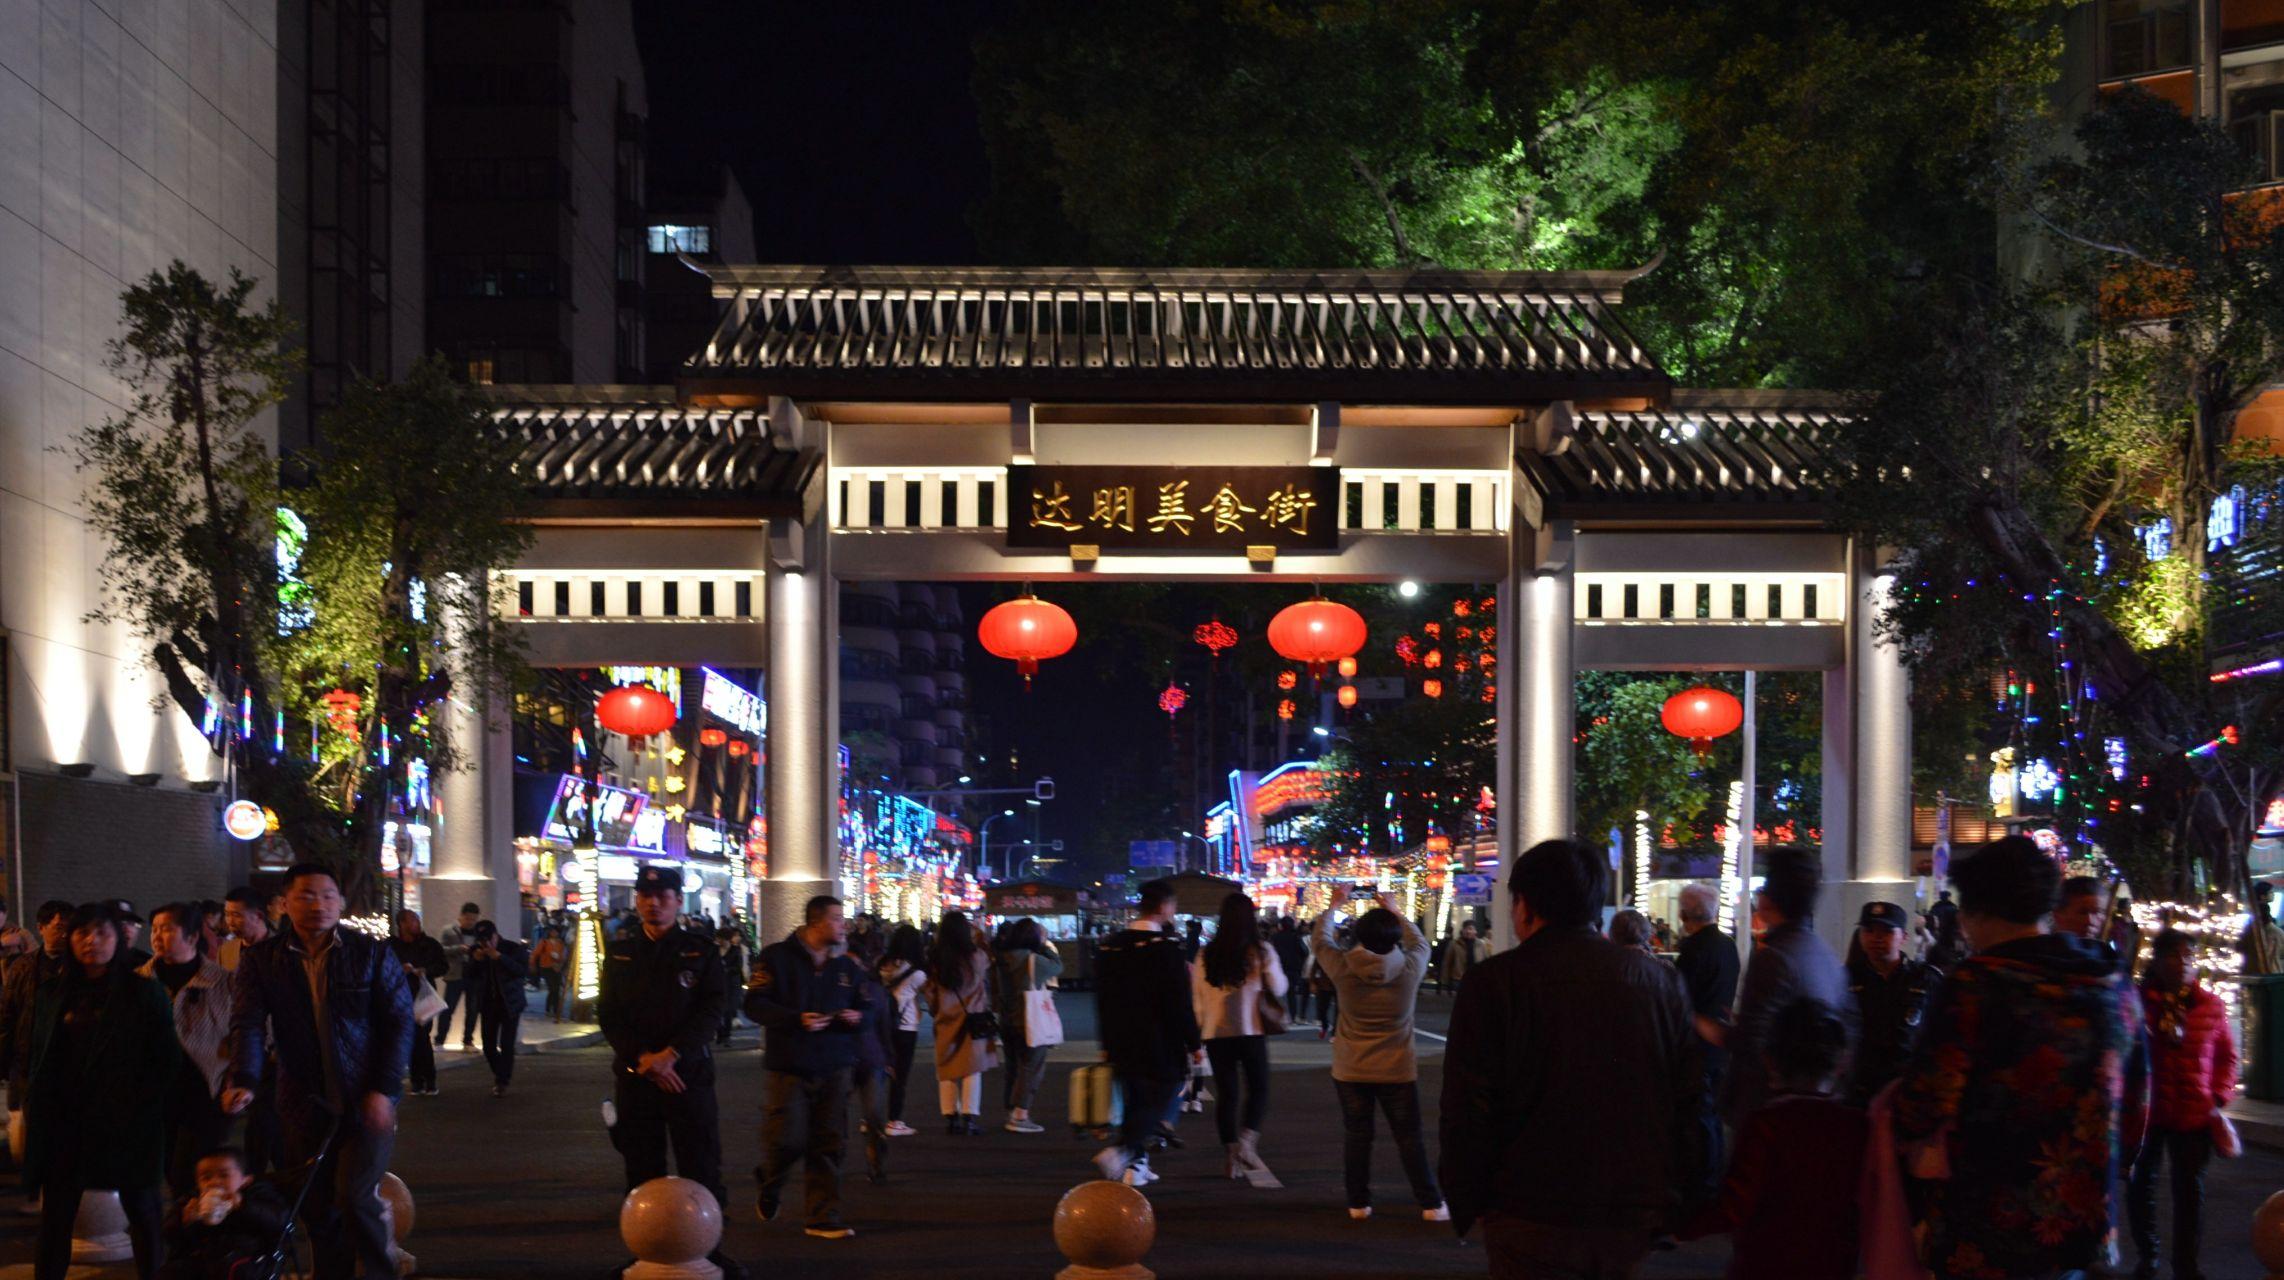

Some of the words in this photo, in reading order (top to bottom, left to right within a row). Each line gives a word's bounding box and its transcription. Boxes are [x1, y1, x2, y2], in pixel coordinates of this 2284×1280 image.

[1030, 480, 1317, 535] 达明美食街
